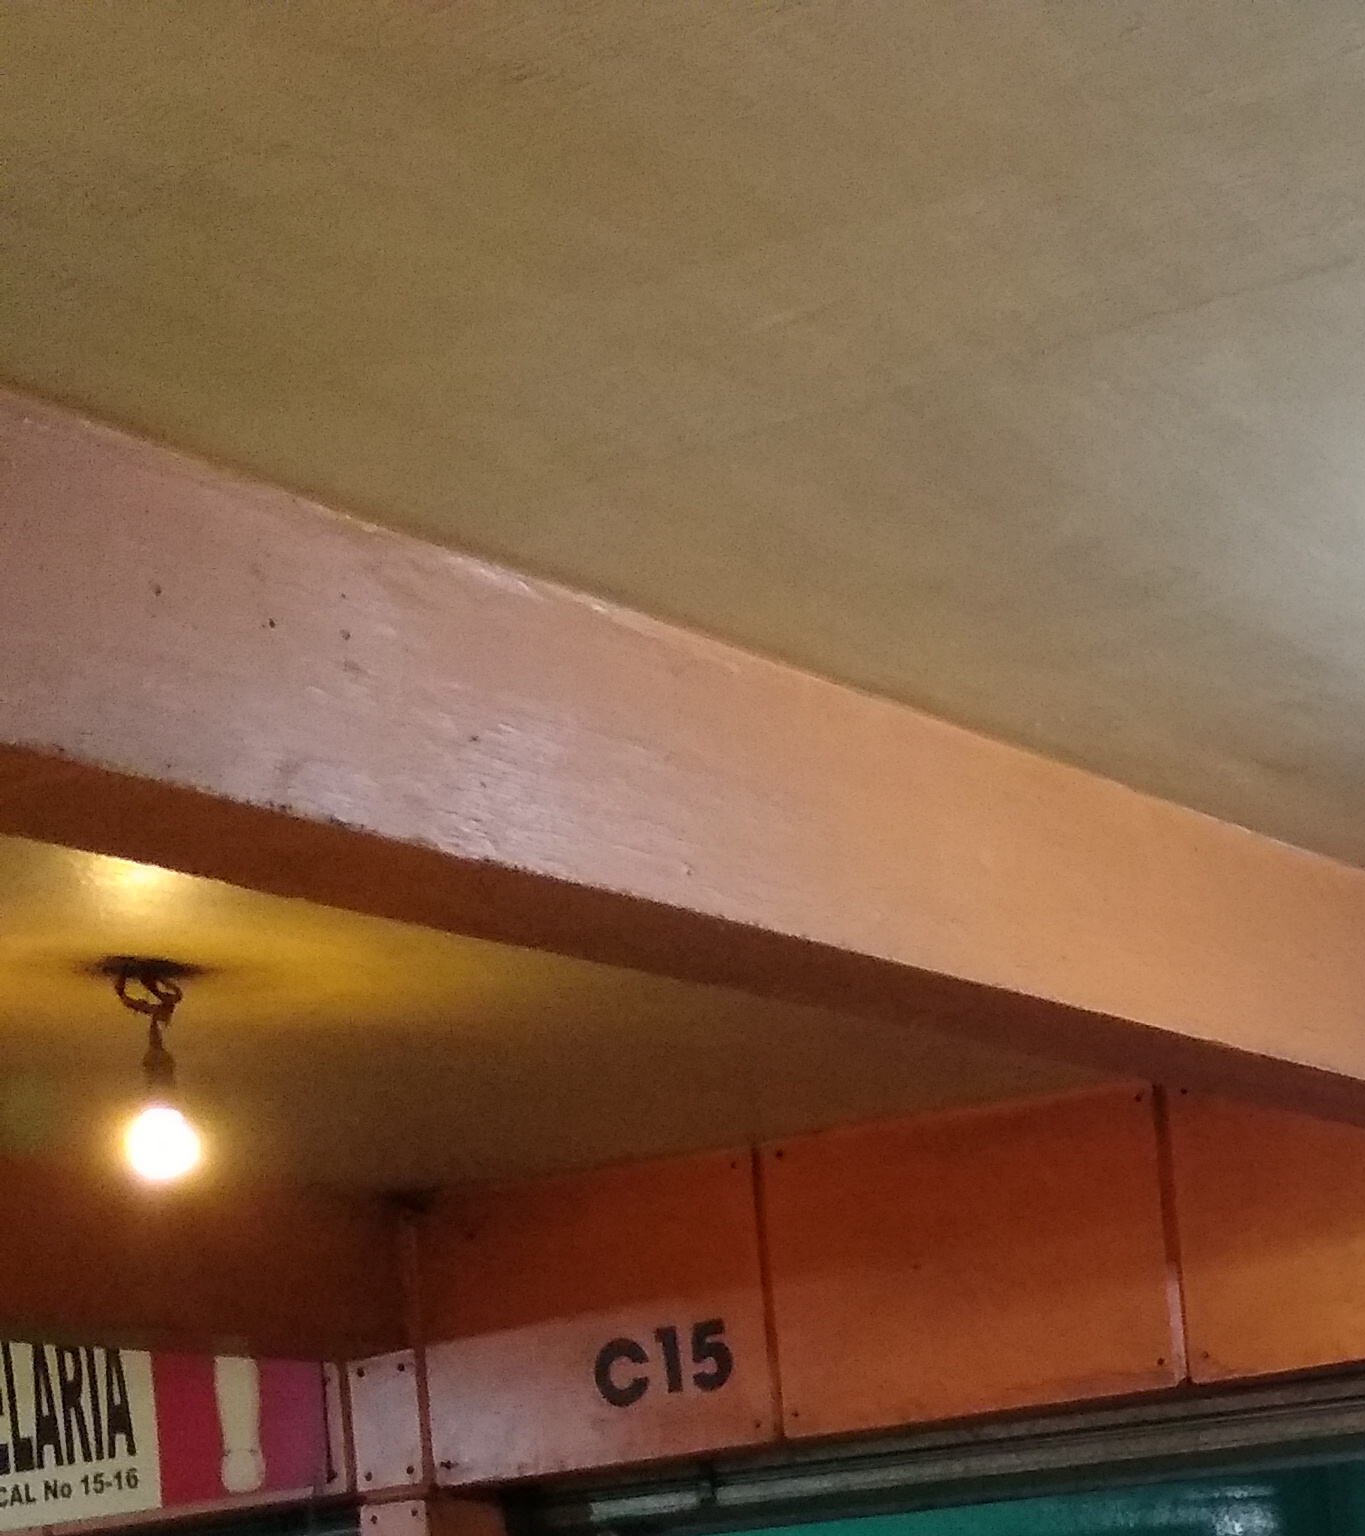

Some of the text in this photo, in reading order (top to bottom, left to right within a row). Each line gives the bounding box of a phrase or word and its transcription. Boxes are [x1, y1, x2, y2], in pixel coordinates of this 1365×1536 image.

[595, 1318, 733, 1407] C15
[44, 1480, 72, 1501] No
[81, 1468, 138, 1496] 15-16
